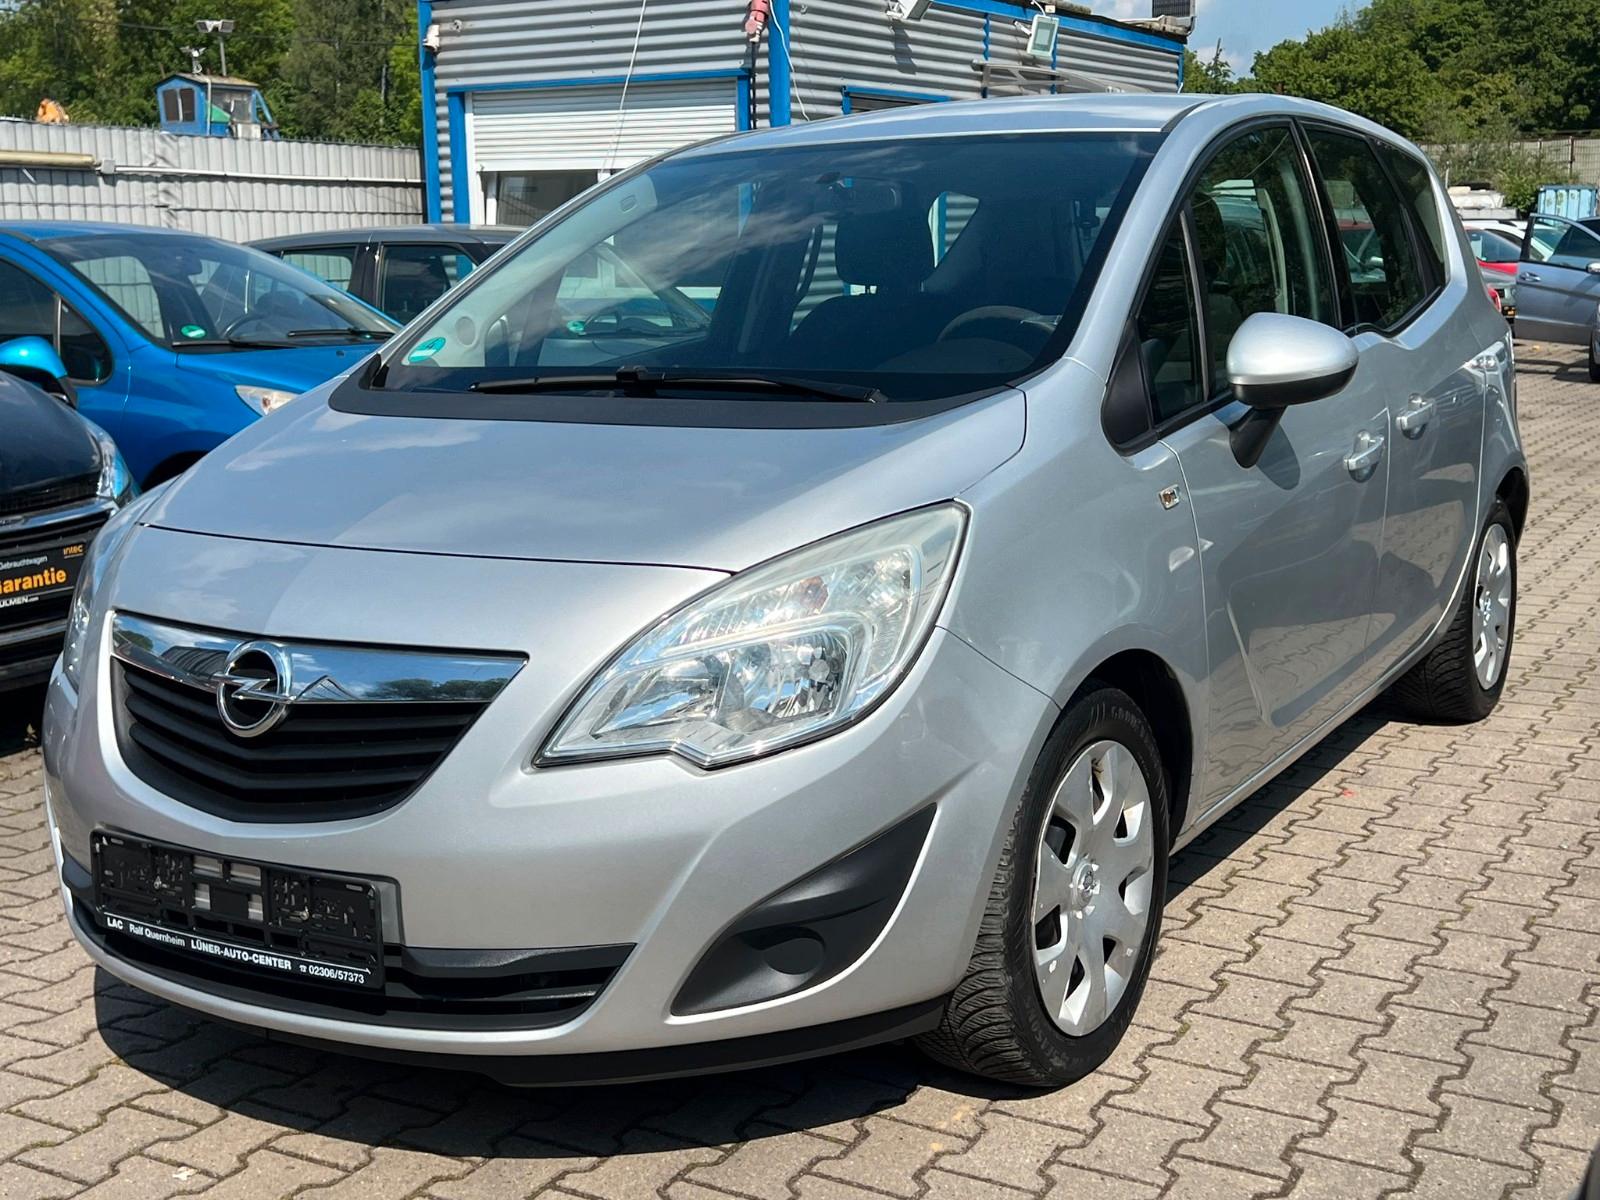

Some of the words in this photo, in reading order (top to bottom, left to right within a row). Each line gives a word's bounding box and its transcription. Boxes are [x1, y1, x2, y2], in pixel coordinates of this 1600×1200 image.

[0, 567, 67, 594] arantie
[107, 917, 123, 930] LAC
[129, 924, 144, 936] Ralf
[145, 928, 185, 947] Quernheim
[190, 939, 292, 970] LÜNER-AUTO-CENTER
[309, 964, 365, 984] 02306/57373
